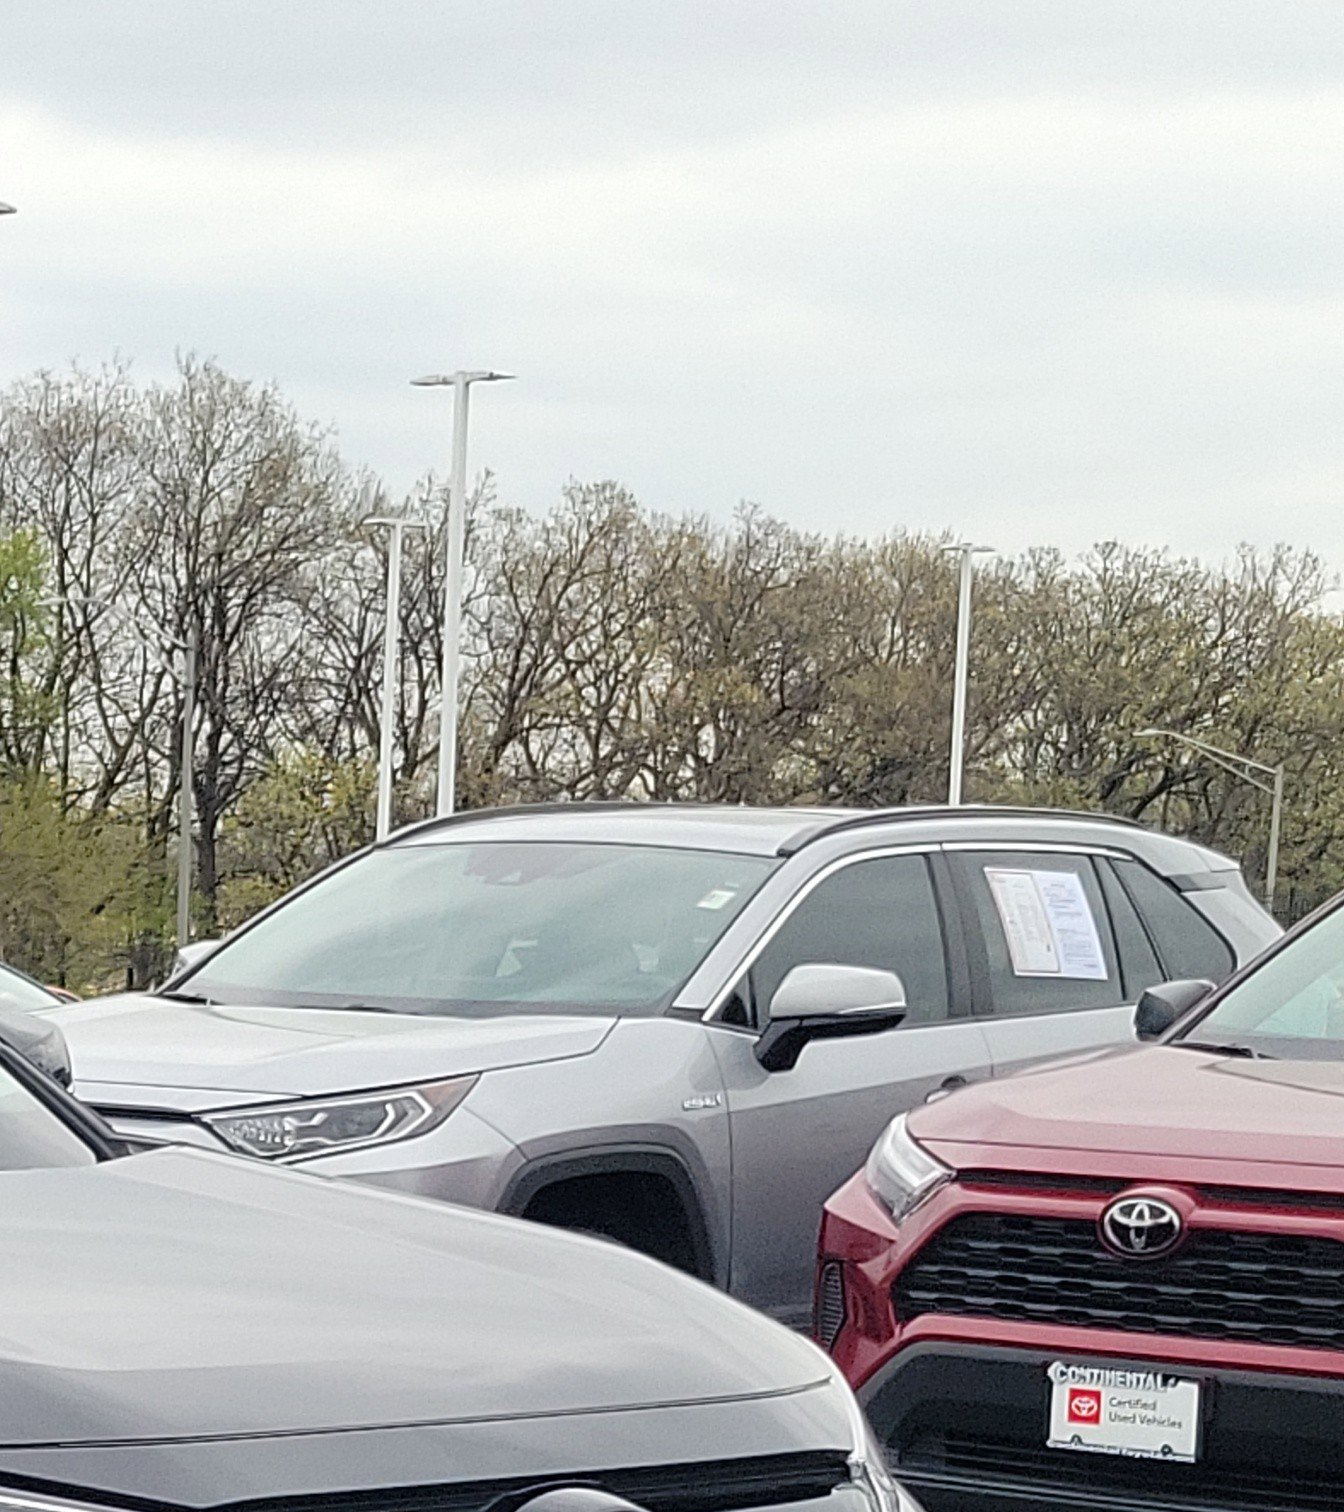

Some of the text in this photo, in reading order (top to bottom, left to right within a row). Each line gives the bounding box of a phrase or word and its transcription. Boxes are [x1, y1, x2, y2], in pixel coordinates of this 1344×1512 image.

[1055, 1364, 1167, 1393] CONTINENTAL
[1109, 1397, 1156, 1411] Certified
[1109, 1412, 1182, 1429] Used Vehicles
